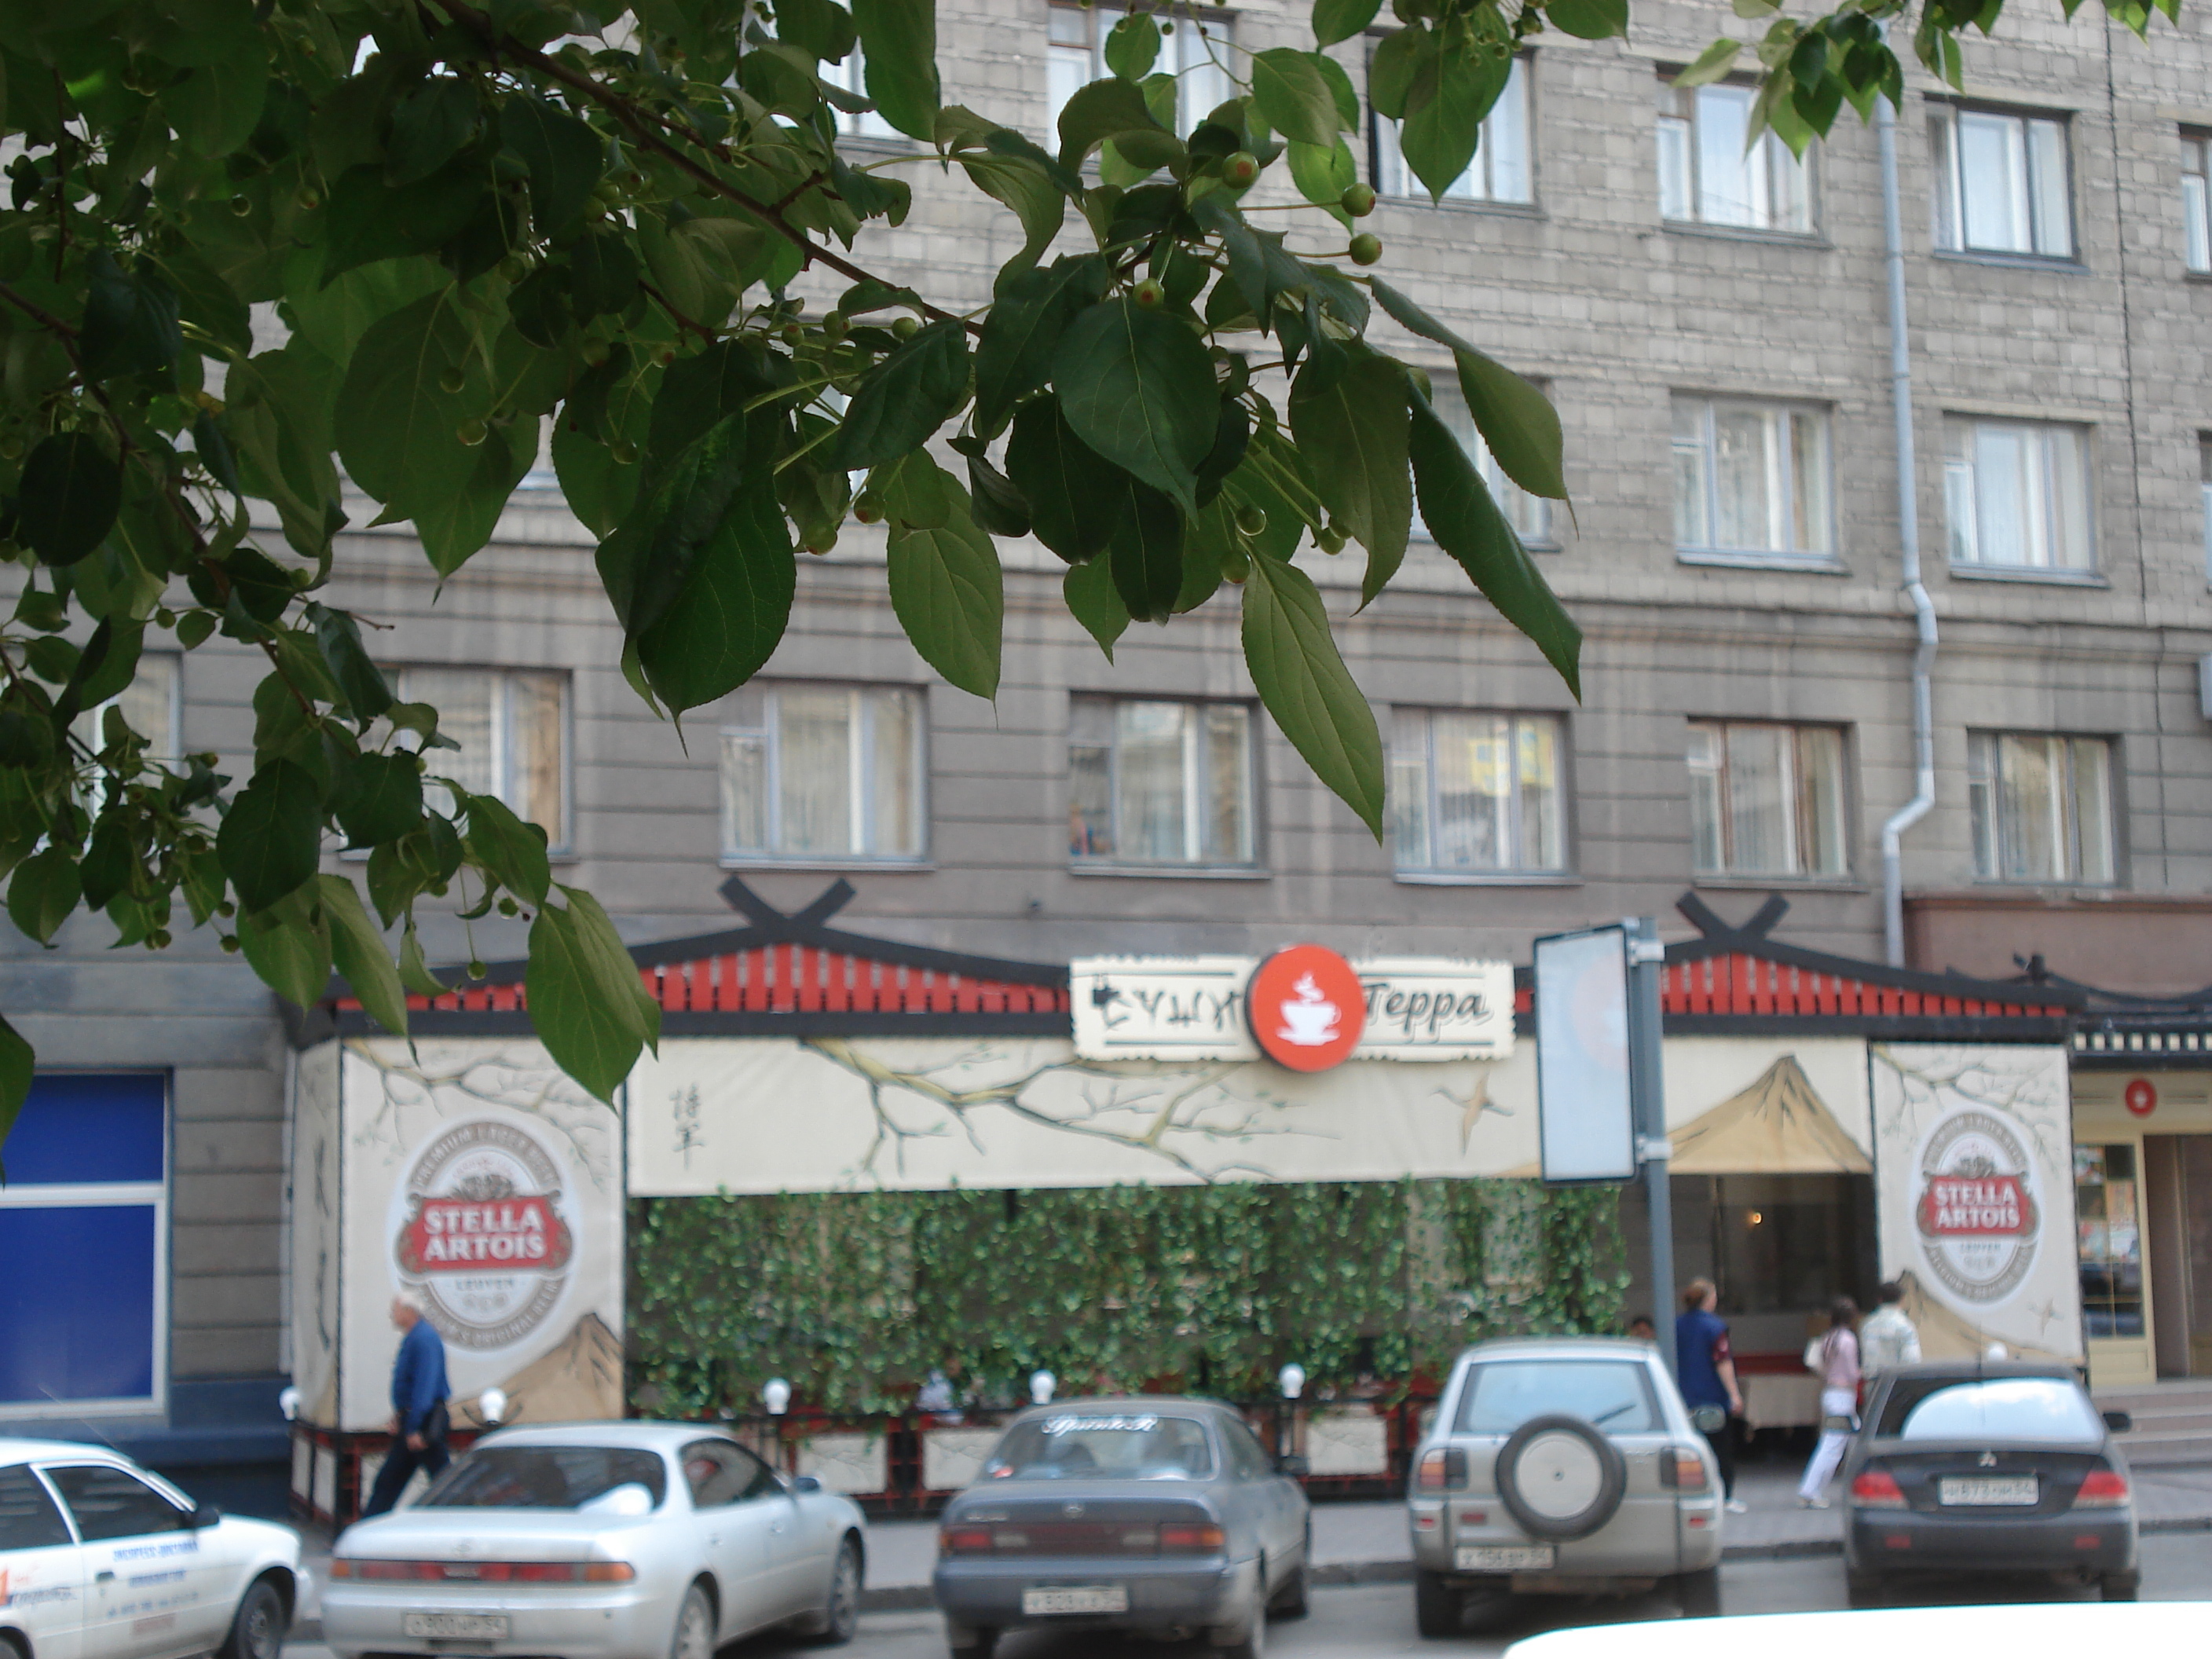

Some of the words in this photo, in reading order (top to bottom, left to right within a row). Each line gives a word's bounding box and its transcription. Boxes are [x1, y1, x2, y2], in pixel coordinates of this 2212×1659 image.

[1363, 983, 1489, 1038] Терра
[1935, 1181, 2018, 1207] STELLA
[424, 1205, 543, 1235] STELLA
[1937, 1207, 2020, 1229] ARTOIS
[425, 1235, 545, 1261] ARTOIS
